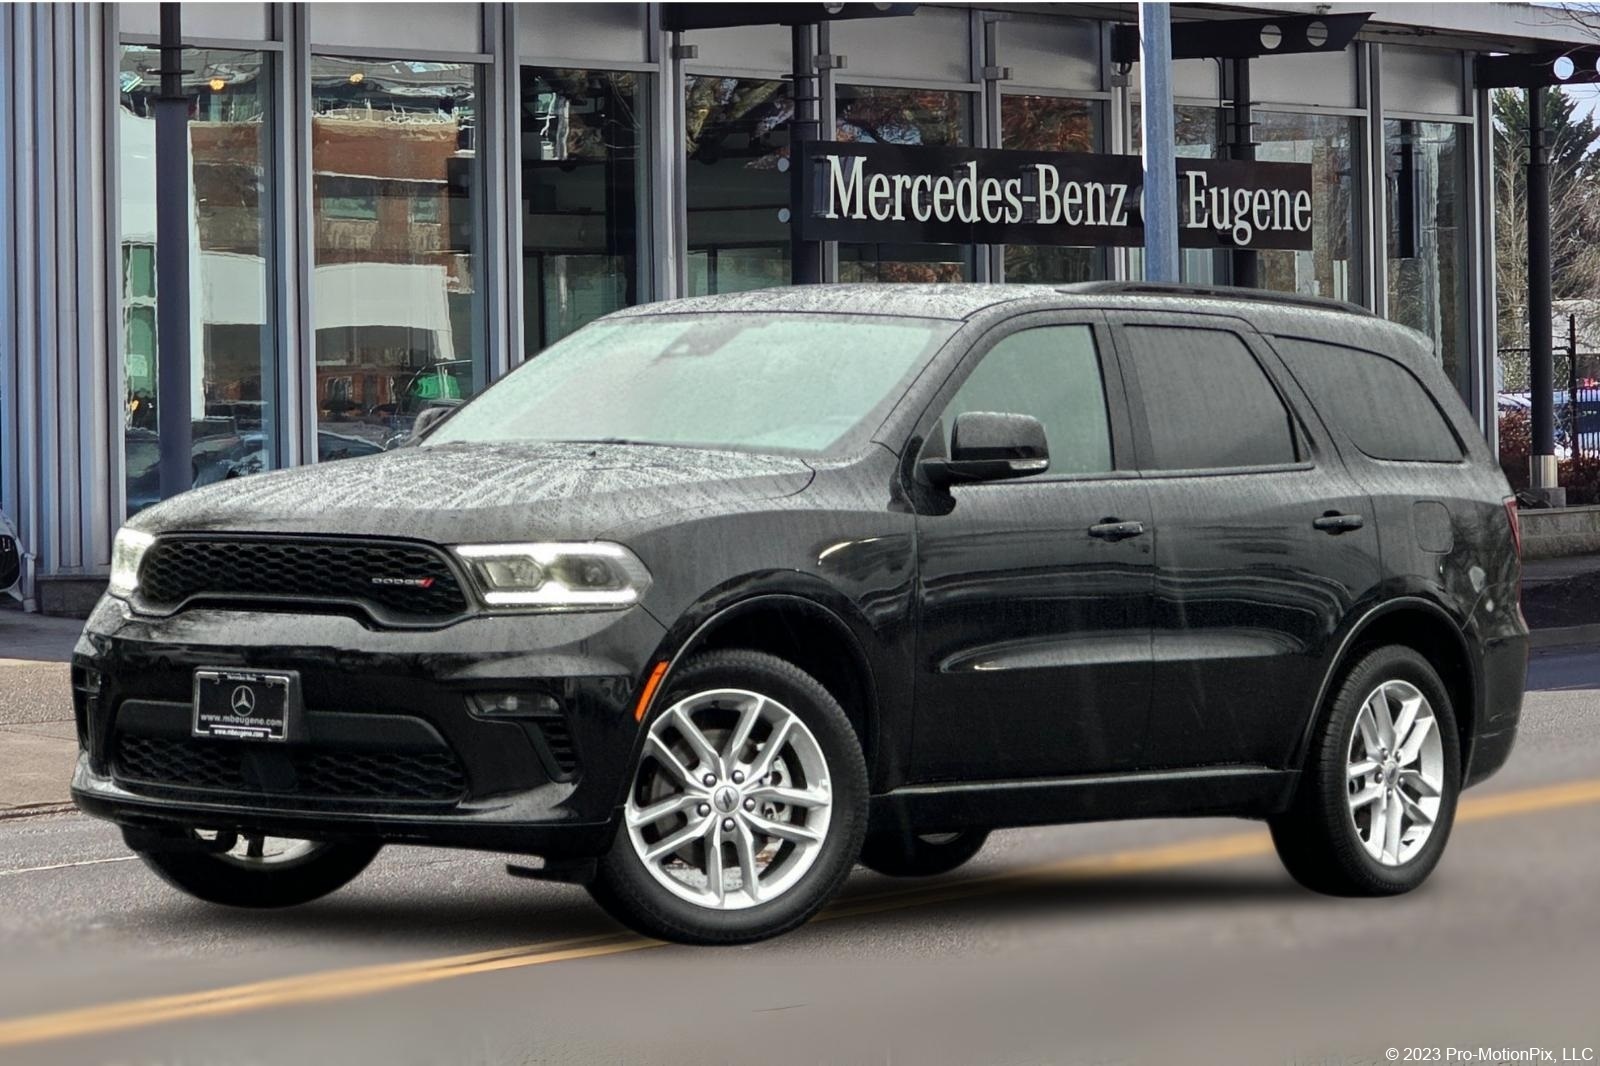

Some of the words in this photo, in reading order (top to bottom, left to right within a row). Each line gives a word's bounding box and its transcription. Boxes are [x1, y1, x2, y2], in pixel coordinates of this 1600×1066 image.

[824, 154, 1128, 226] Mercedes-Benz
[1186, 170, 1311, 246] Eugene
[371, 577, 422, 586] DODGE
[200, 714, 283, 727] www.mbeugene.com
